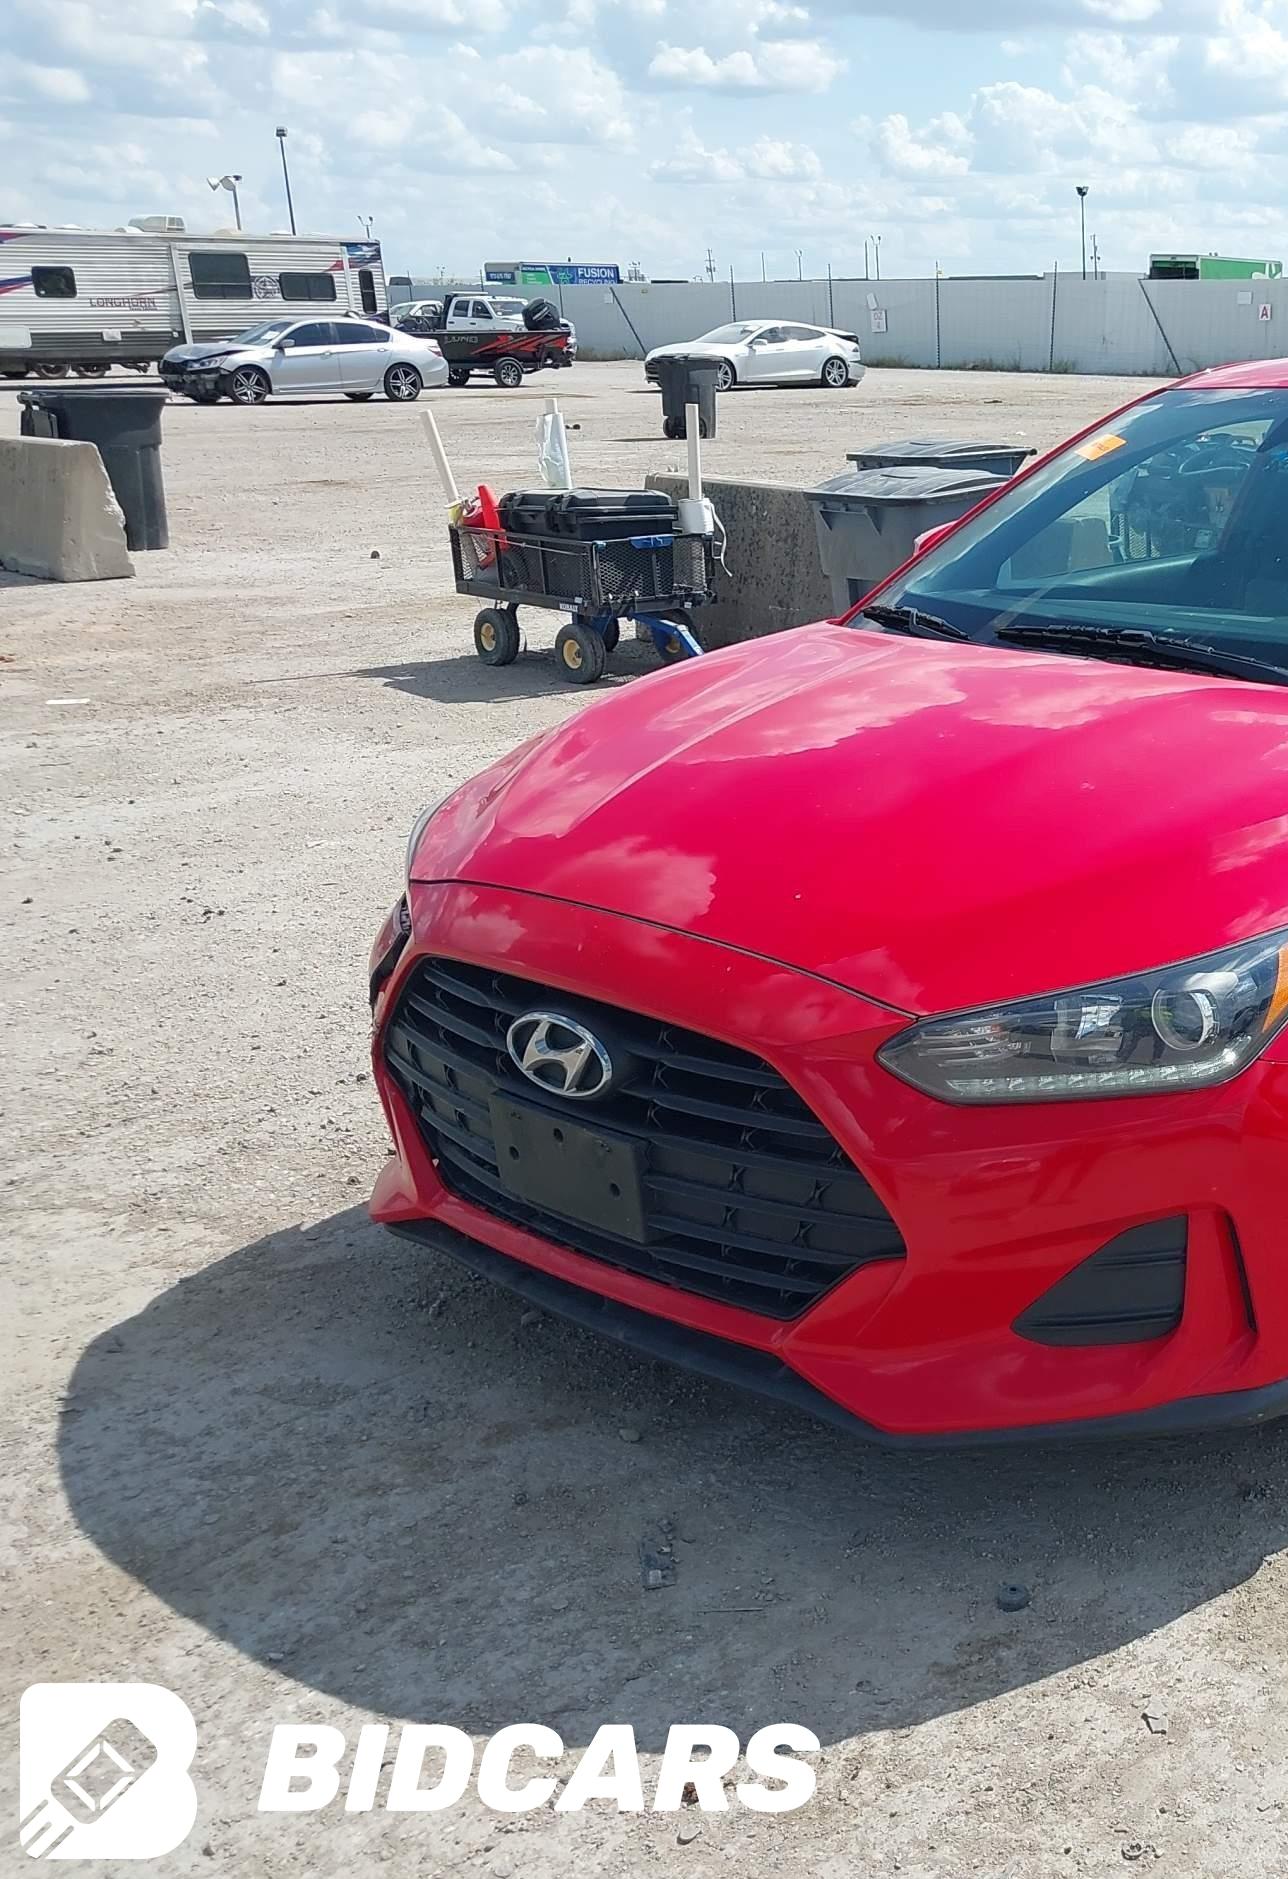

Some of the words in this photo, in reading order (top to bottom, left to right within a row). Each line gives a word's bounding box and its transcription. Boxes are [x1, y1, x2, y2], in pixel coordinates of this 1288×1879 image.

[577, 267, 615, 278] FUSION
[88, 297, 157, 307] LONGHORN
[1260, 305, 1269, 319] A
[444, 335, 479, 344] LUND
